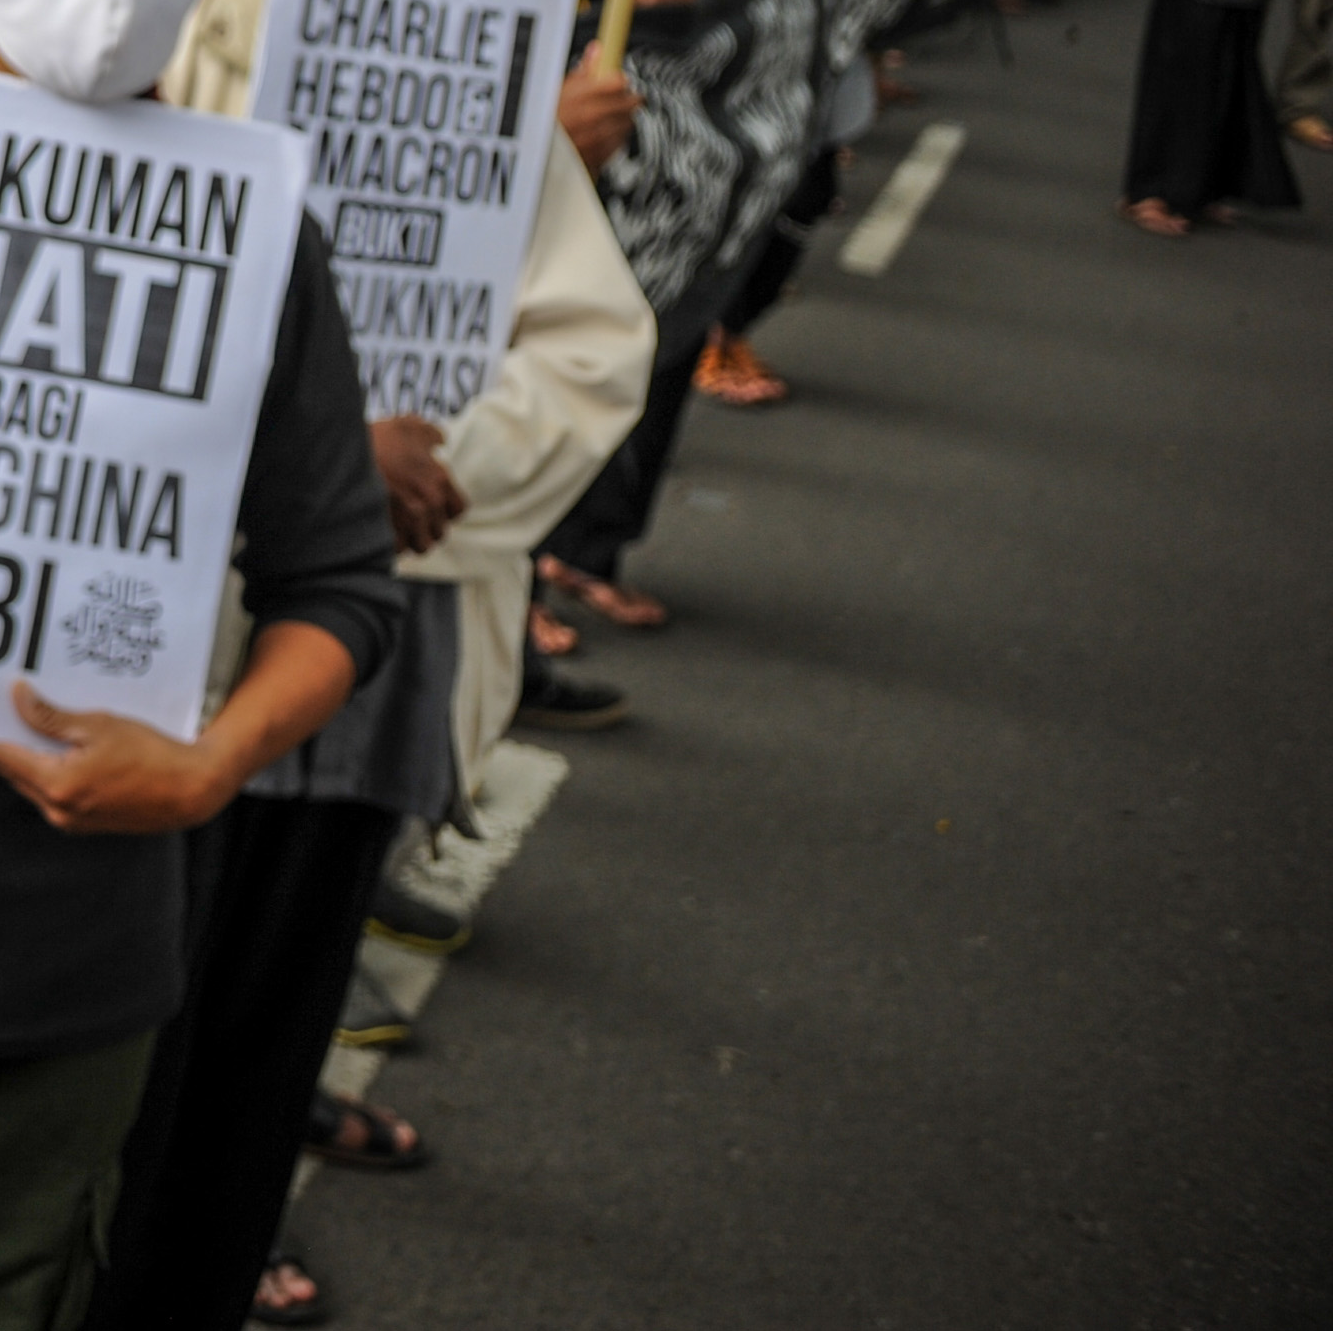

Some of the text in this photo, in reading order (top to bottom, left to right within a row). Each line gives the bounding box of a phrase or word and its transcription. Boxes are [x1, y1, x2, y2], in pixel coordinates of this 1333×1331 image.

[288, 55, 452, 132] HEBDO
[312, 128, 520, 206] MACRON
[339, 274, 493, 343] UKNYA
